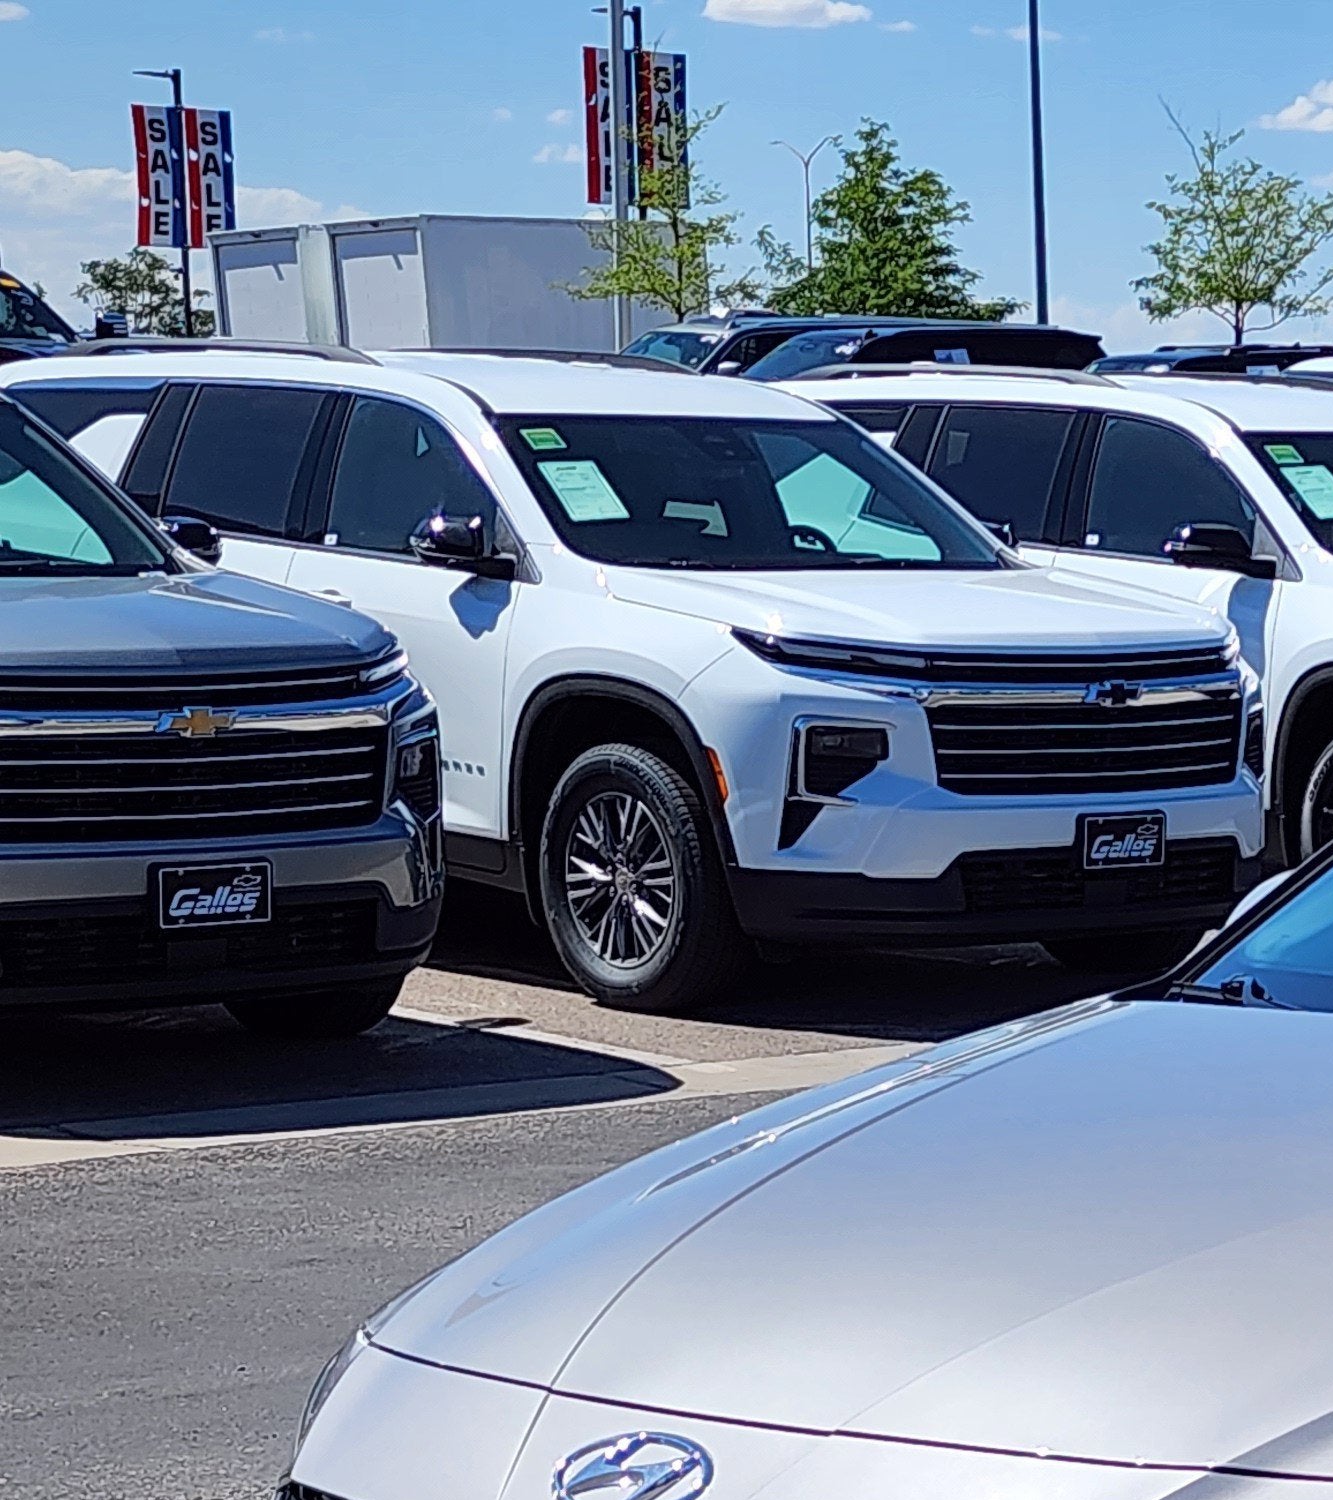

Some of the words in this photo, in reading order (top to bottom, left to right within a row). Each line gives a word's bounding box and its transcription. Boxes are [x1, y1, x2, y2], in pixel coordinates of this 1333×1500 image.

[148, 118, 170, 236] SALE
[200, 121, 222, 232] SALE
[1090, 832, 1157, 860] Galles
[168, 885, 261, 917] Galles
